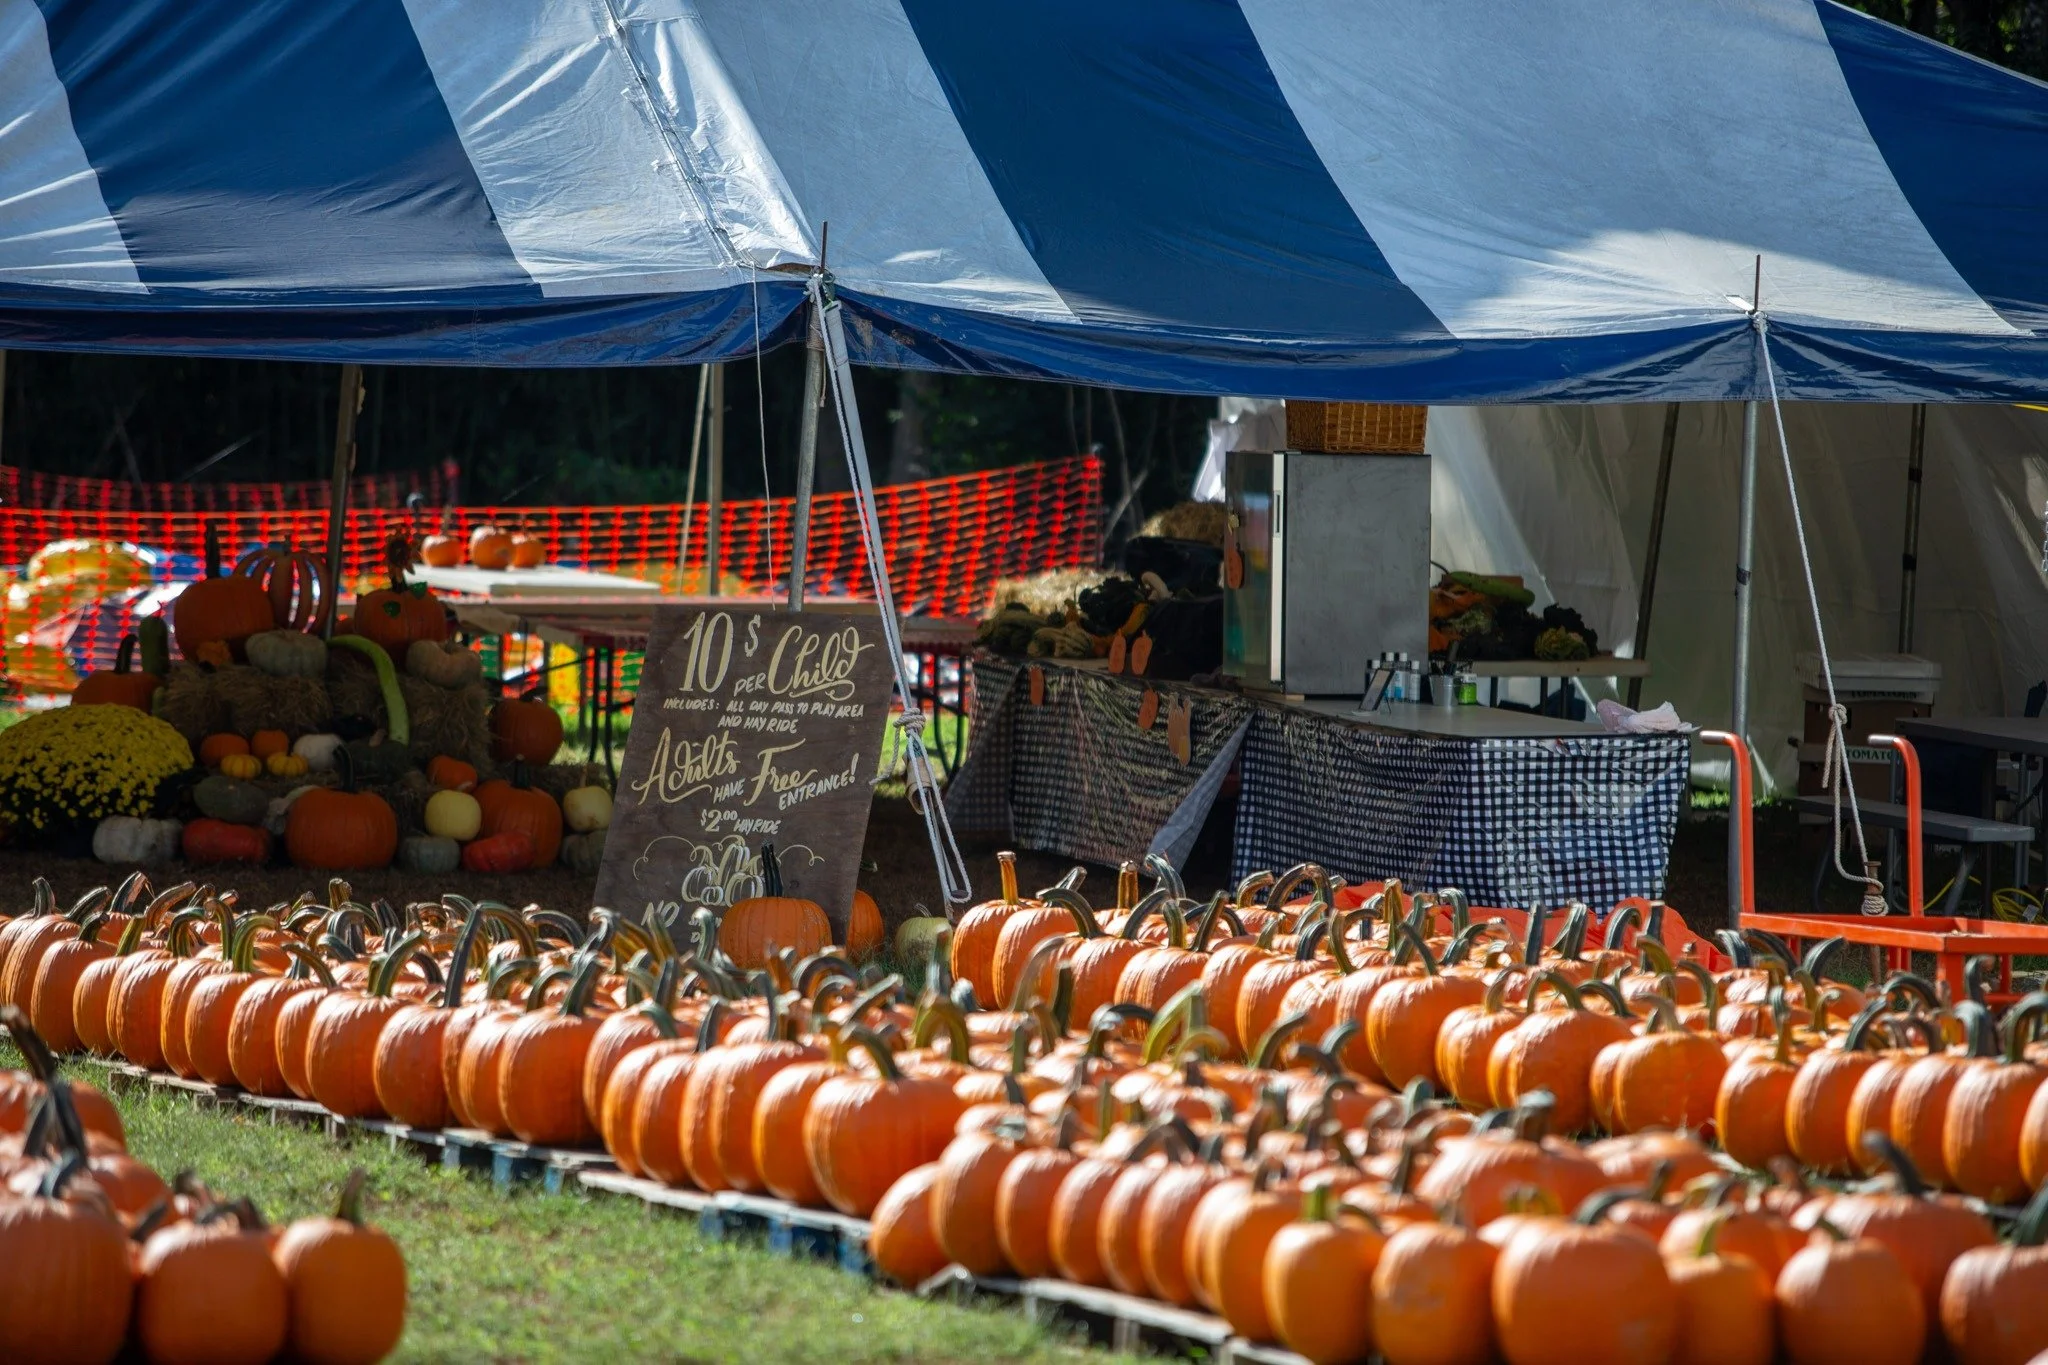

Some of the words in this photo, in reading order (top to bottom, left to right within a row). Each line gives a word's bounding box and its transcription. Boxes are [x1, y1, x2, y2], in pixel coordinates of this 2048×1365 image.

[734, 672, 767, 697] PER
[767, 625, 875, 701] Child
[663, 698, 720, 711] INCLUDES:
[726, 700, 744, 713] ALL
[749, 700, 768, 714] DAY
[771, 701, 794, 715] PASS
[796, 702, 809, 715] TO
[810, 702, 836, 717] PLAY
[835, 704, 864, 718] AREA
[717, 715, 741, 728] AND
[631, 727, 741, 805] Adults
[743, 738, 818, 807] Free
[778, 753, 860, 811] ENTRANCE!
[712, 778, 746, 804] HAVE
[700, 809, 738, 832] $2.00
